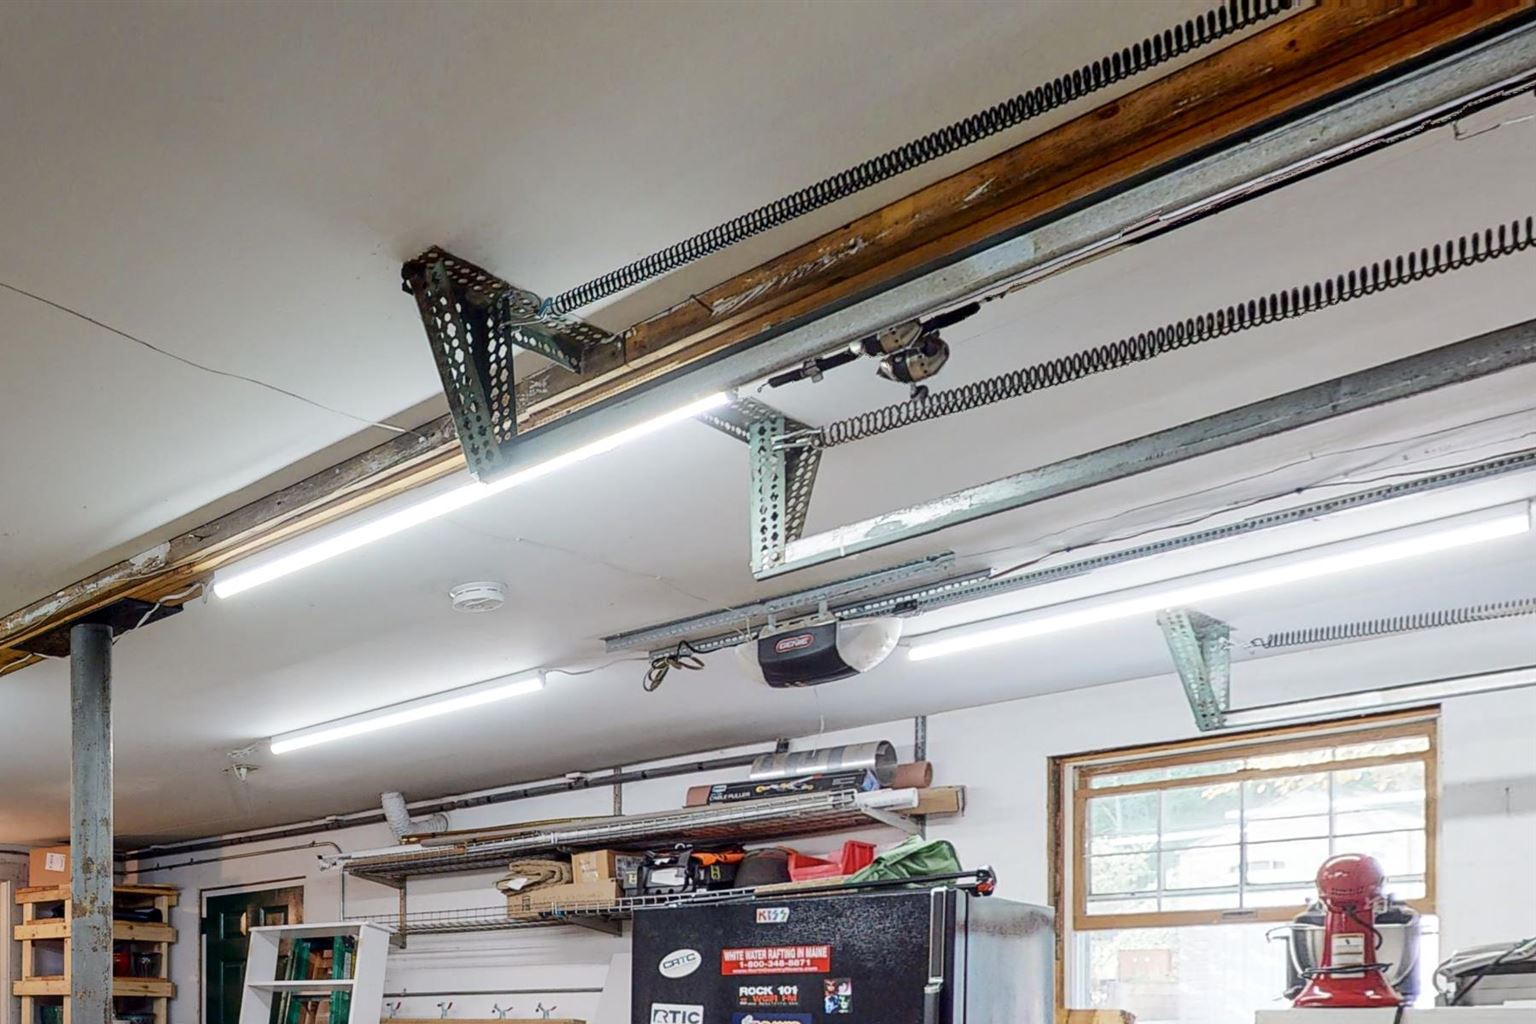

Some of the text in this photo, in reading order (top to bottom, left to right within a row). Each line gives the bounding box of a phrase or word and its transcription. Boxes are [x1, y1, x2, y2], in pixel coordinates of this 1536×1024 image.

[779, 637, 810, 650] GENIE
[758, 909, 788, 921] KISS
[724, 945, 828, 961] WHITE WATER RAFTING IN MAINE
[739, 985, 799, 996] ROCK 101
[653, 1009, 700, 1024] RTIC
